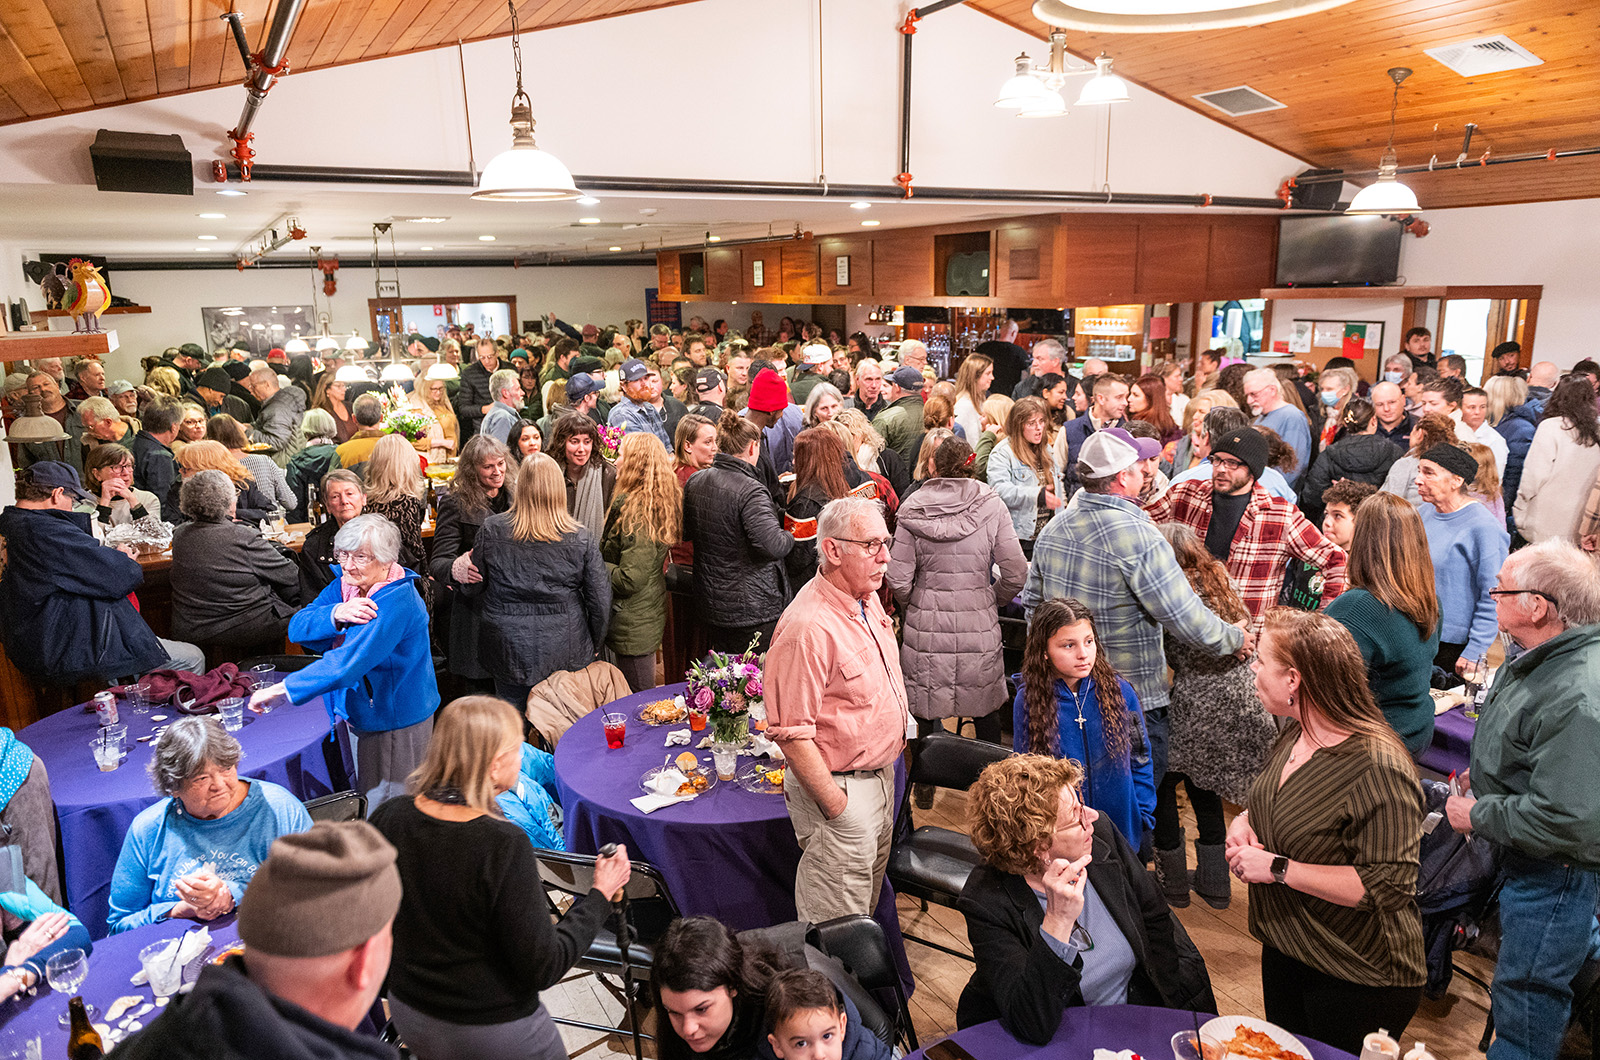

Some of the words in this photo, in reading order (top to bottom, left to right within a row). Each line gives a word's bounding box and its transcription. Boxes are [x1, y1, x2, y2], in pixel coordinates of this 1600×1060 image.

[1293, 588, 1319, 610] CELTI
[174, 854, 207, 878] Where
[210, 849, 229, 860] You
[230, 852, 248, 867] Can
